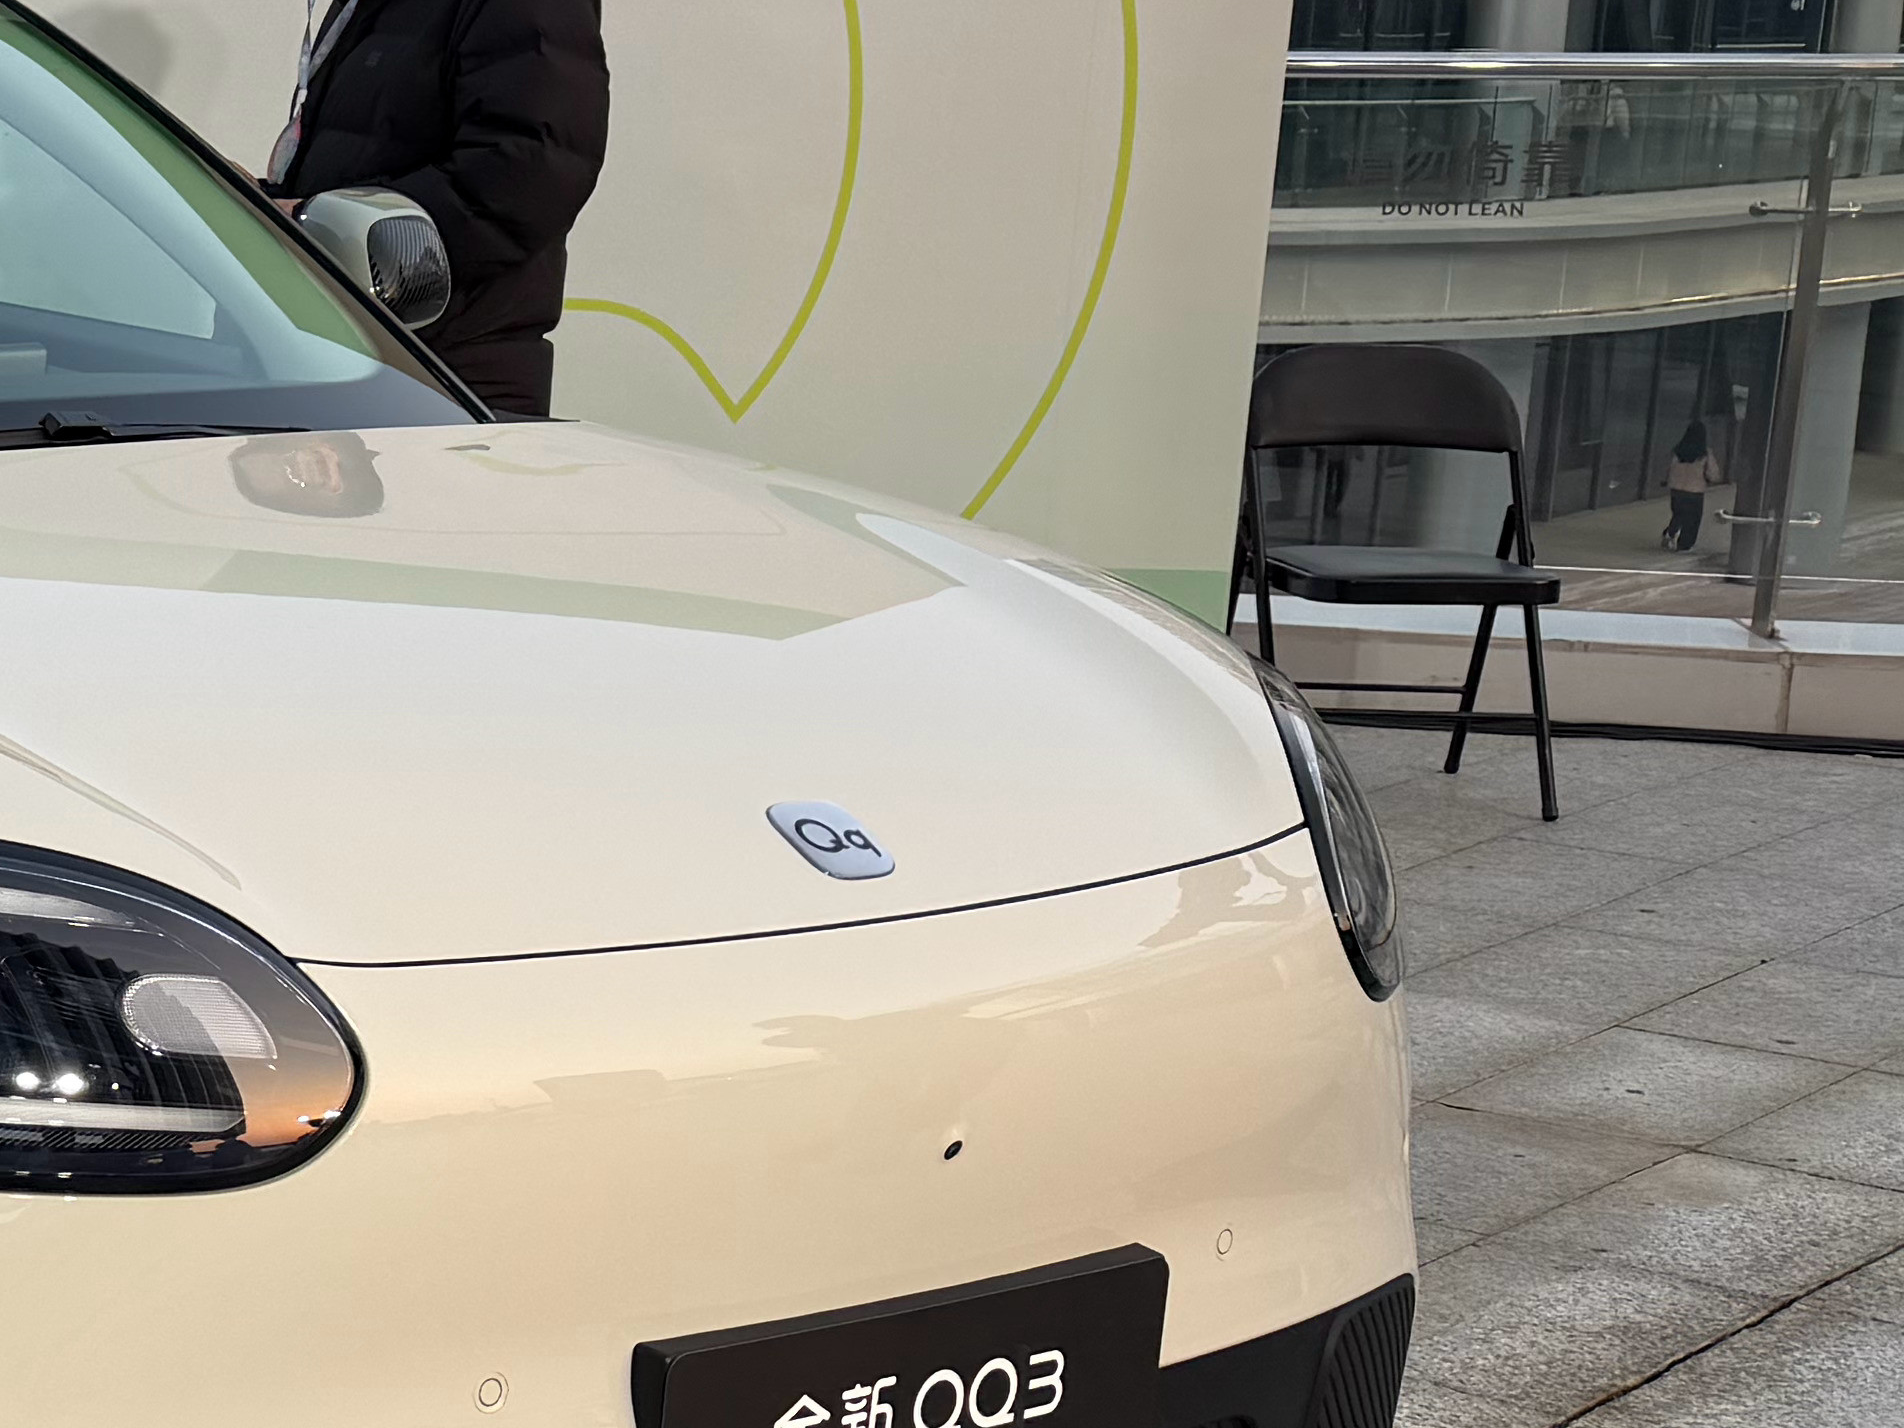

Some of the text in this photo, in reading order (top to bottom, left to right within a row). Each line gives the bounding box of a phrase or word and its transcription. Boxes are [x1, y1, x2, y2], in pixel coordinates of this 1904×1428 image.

[1382, 201, 1524, 217] DO NOT LEAN
